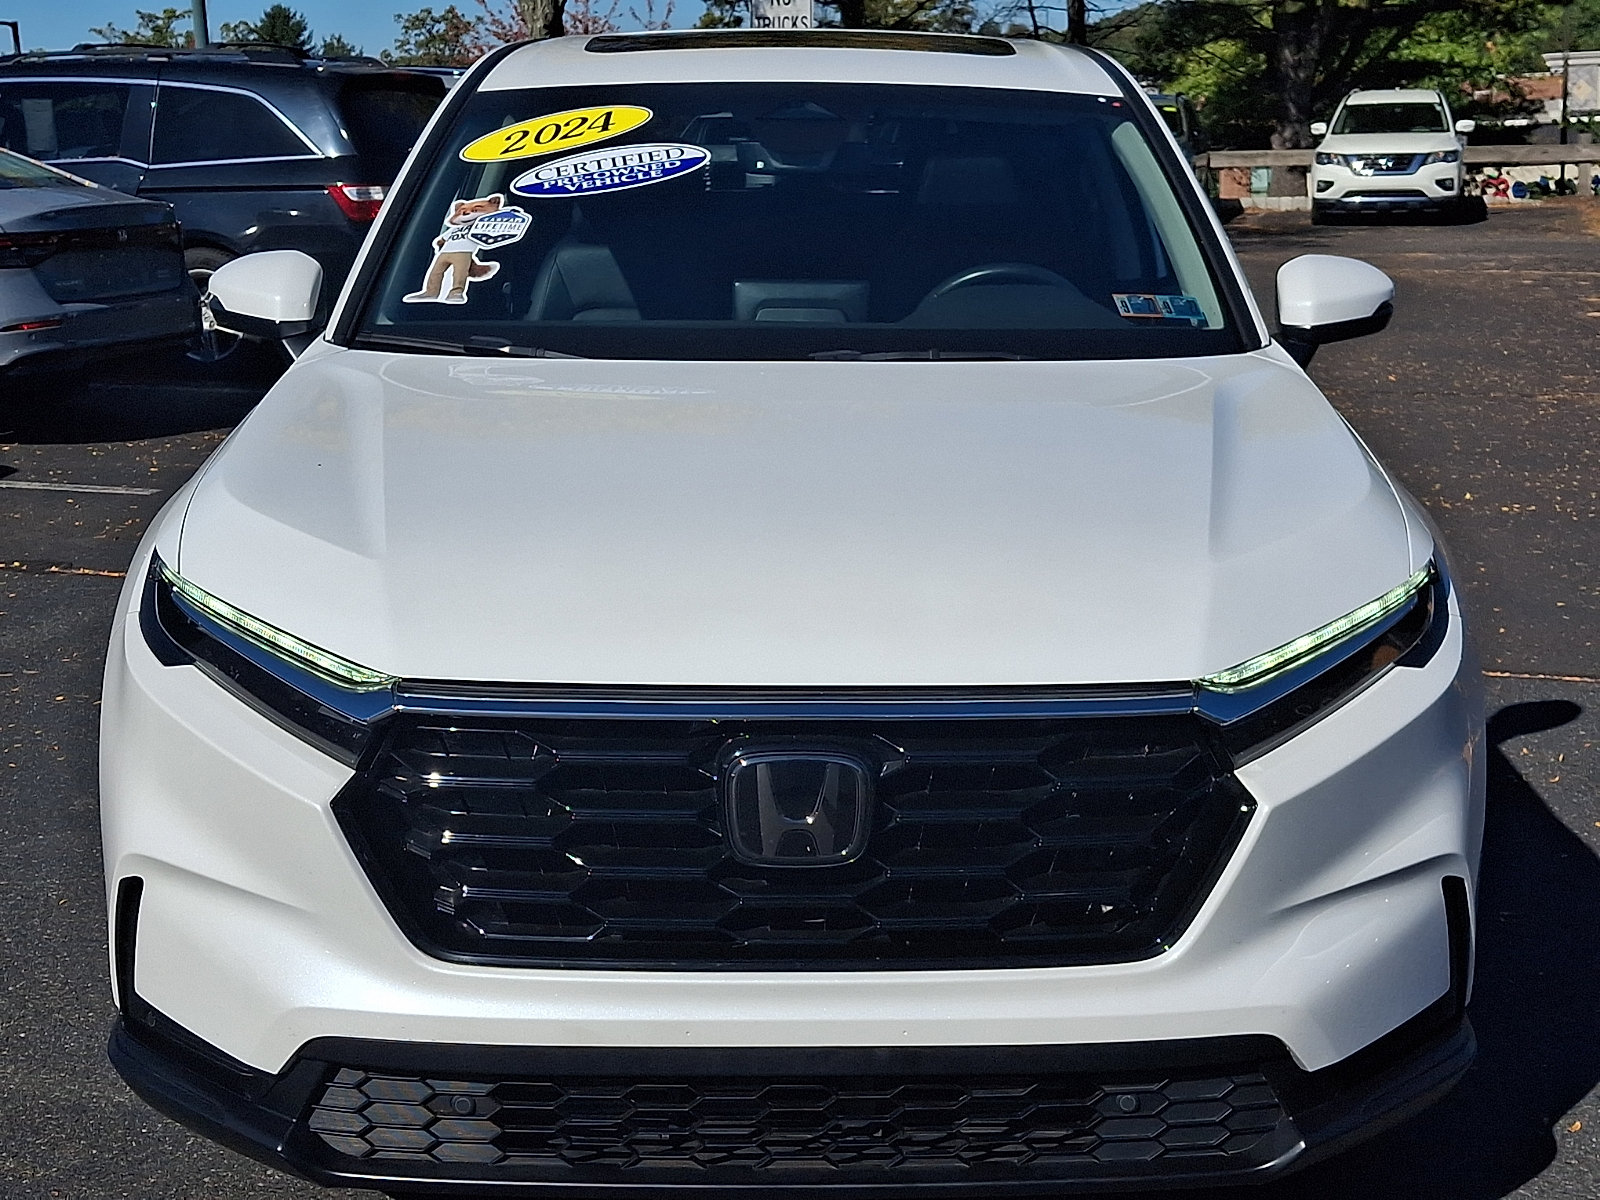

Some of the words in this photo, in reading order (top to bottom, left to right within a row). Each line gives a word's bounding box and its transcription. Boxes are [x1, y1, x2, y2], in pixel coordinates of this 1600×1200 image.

[754, 15, 809, 28] TRUCKS
[499, 110, 616, 155] 2024
[534, 147, 685, 181] CERTIFIED
[542, 160, 682, 189] PRE-OWNED
[563, 169, 663, 192] VEHICLE
[475, 222, 521, 230] LIFETIME
